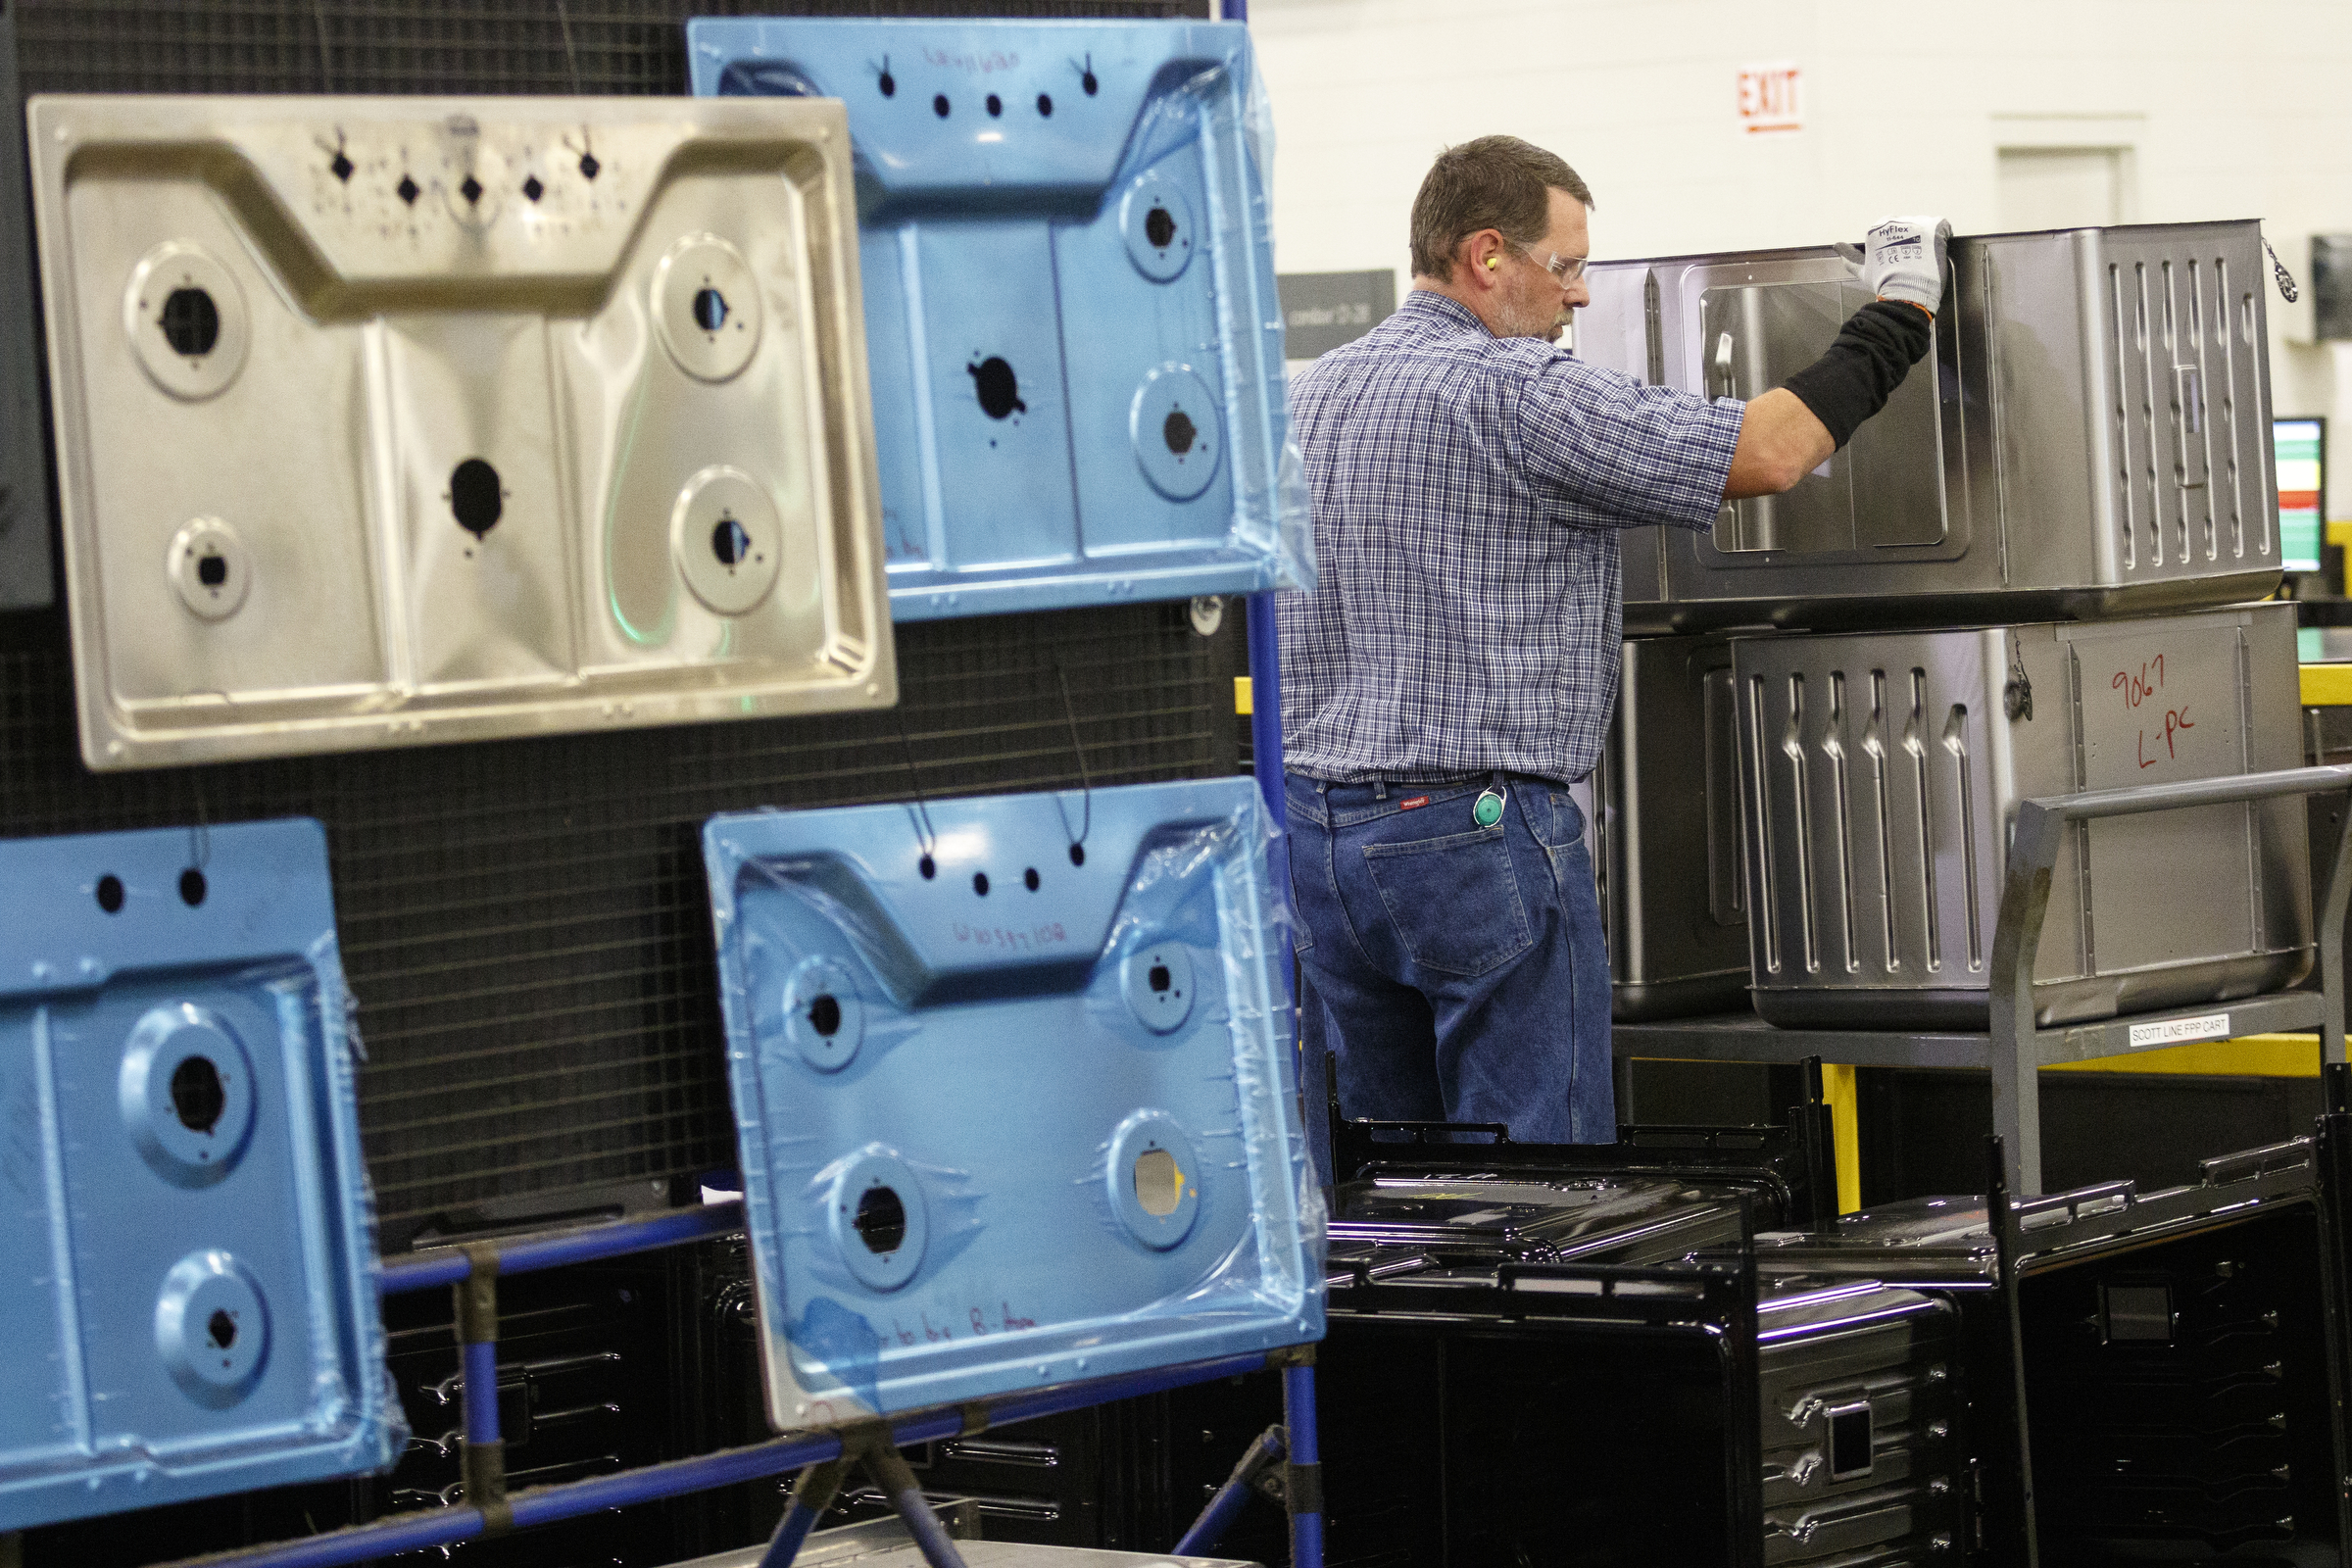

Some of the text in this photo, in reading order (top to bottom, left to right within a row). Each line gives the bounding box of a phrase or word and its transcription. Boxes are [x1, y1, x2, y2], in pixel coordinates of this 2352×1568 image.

[1738, 70, 1800, 118] EXIT
[1879, 225, 1909, 237] HyFlex
[2112, 654, 2164, 710] 9067
[2132, 1018, 2227, 1042] SCOTT LINE FPP CART
